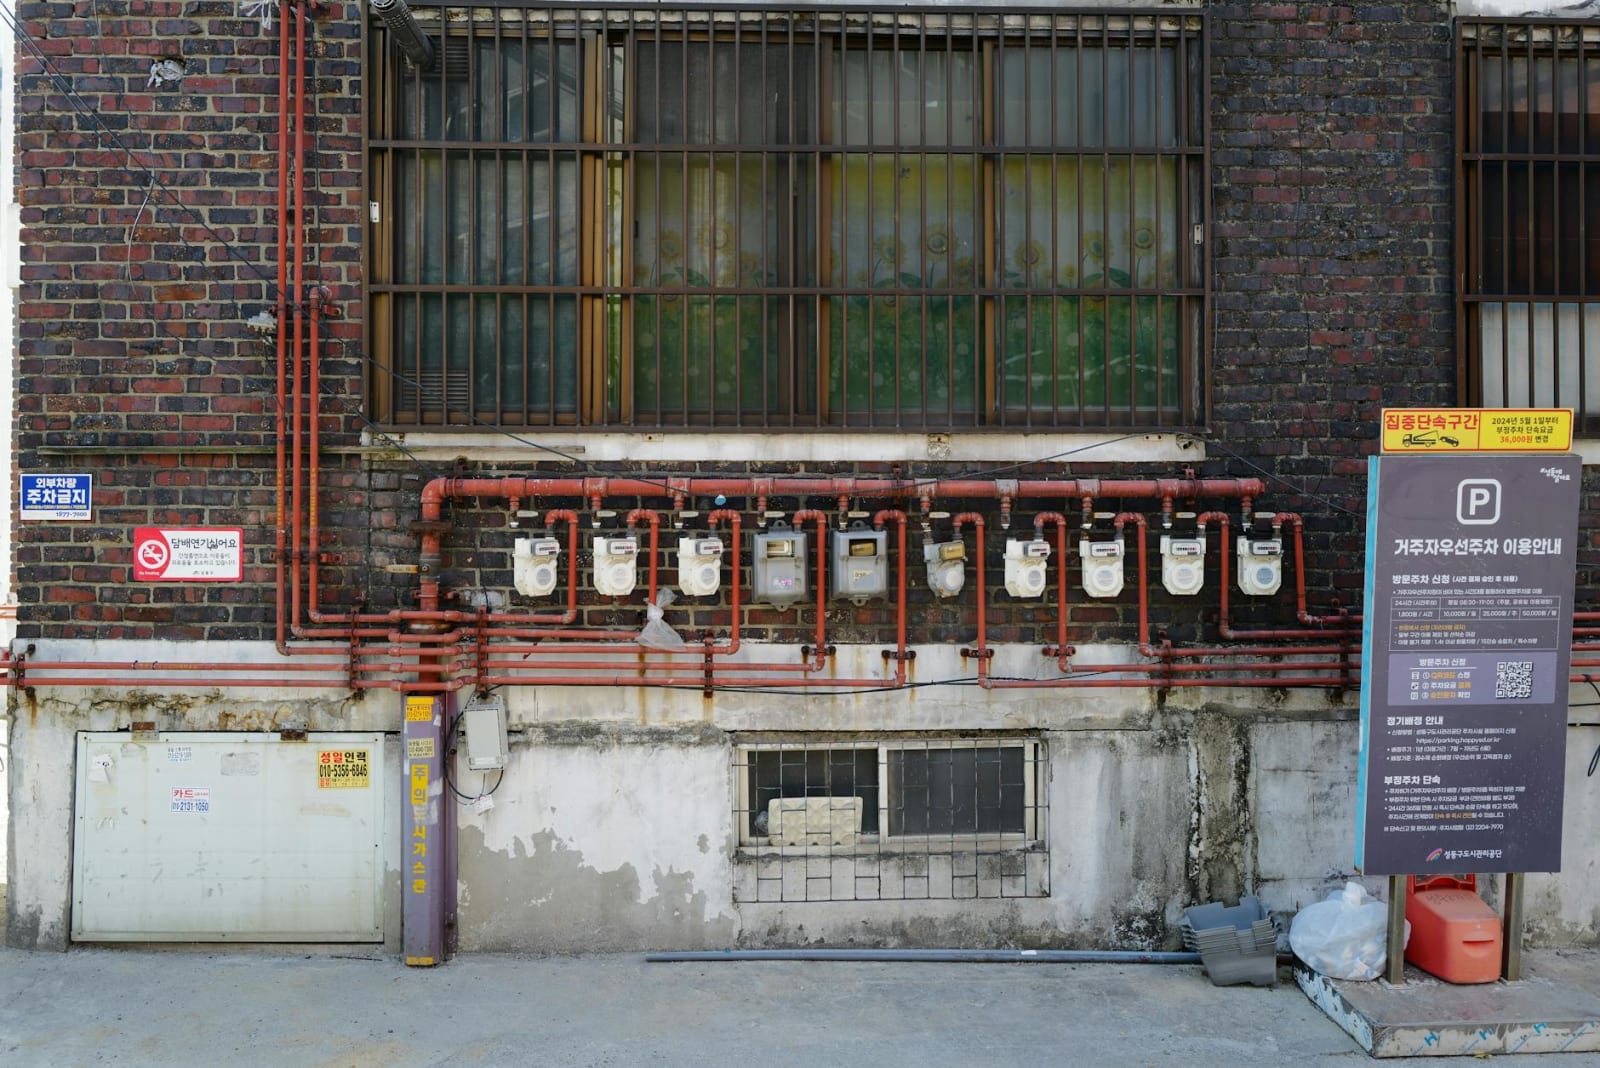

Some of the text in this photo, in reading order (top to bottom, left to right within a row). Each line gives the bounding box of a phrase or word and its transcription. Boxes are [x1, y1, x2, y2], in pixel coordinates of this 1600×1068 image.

[1386, 414, 1478, 430] 집중단속구간
[1496, 426, 1553, 434] 부정주차 단속요금
[1500, 435, 1532, 444] 36,000원
[36, 477, 77, 488] 외부차량
[27, 489, 86, 504] 주차금지
[1469, 488, 1490, 515] P
[171, 538, 237, 550] 담배연기싫어요
[1394, 539, 1561, 555] 거주자우선주차 이용안내
[1392, 575, 1428, 584] 방문주차
[1432, 575, 1450, 584] 신청
[1419, 658, 1450, 666] 방문주차
[1387, 716, 1443, 725] 정기배정 안내
[320, 751, 366, 763] 성일인력
[413, 767, 426, 802] 주의
[1384, 775, 1440, 784] 부정주차 단속
[173, 789, 194, 798] 카드
[1444, 850, 1502, 860] 성동구도시관리공단
